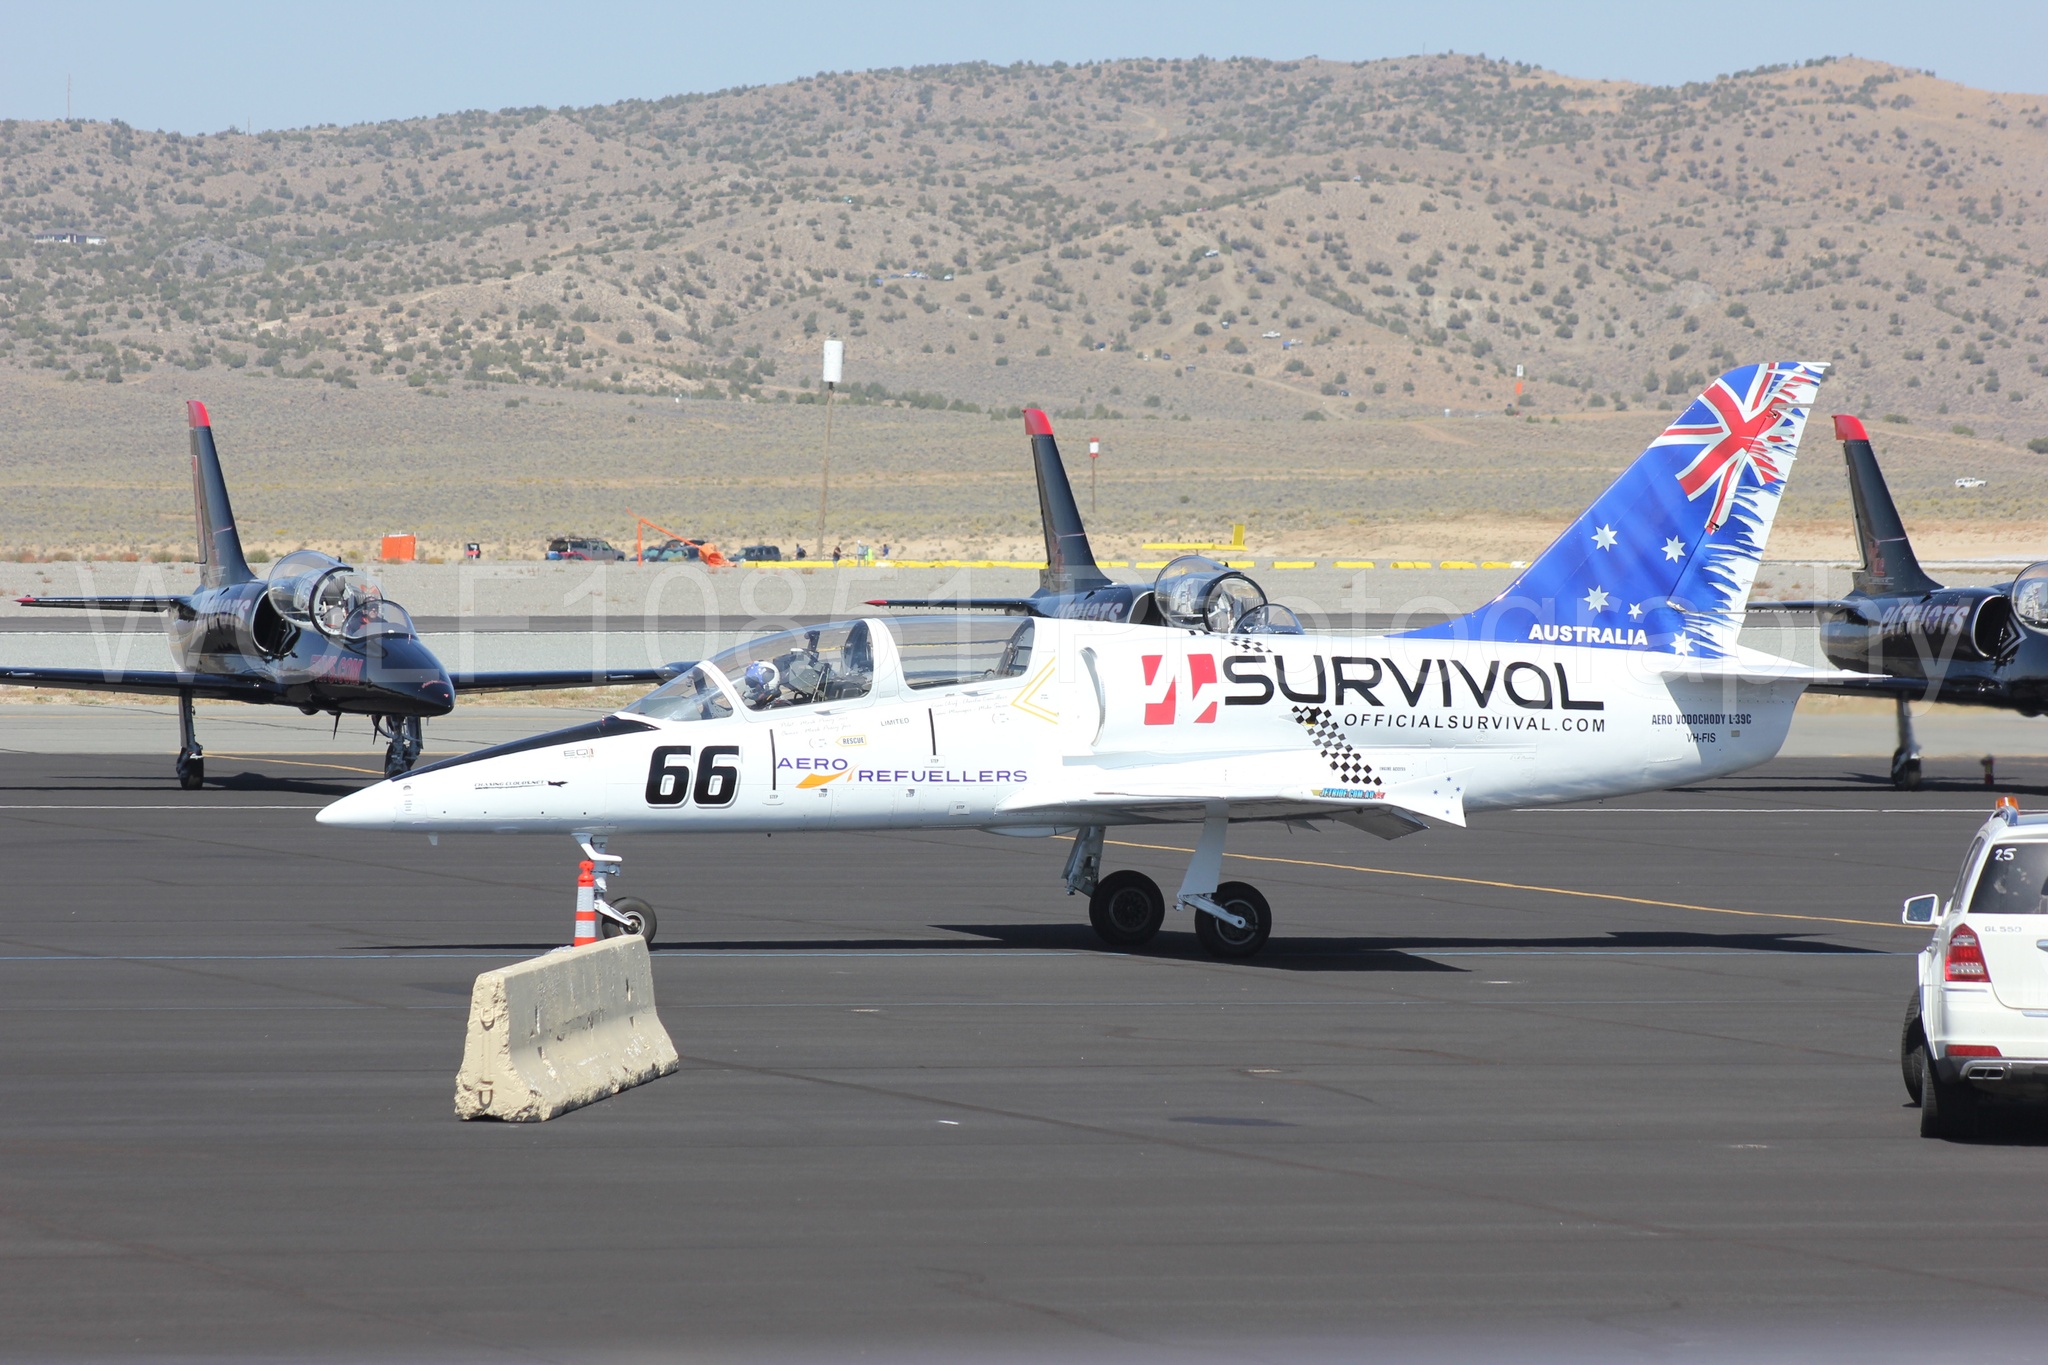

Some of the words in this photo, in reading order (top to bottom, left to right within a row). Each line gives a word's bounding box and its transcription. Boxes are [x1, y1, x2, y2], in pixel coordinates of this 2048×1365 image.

[1876, 604, 1970, 636] PATRIOTS
[1528, 624, 1648, 646] AUSTRALIA
[1222, 654, 1604, 711] SURVIVAL
[880, 717, 910, 727] LIMITED
[1343, 713, 1605, 732] OFFICIALSURVIVAL.COM
[1651, 714, 1673, 725] AERO
[1676, 714, 1726, 725] VODOCHODY
[1728, 714, 1752, 725] L-39C
[842, 737, 865, 745] RESCUE
[1686, 733, 1716, 743] VH-FIS
[777, 757, 848, 770] AERO
[645, 745, 742, 807] 66
[858, 770, 1027, 782] REFUELLERS
[1994, 847, 2017, 861] 25
